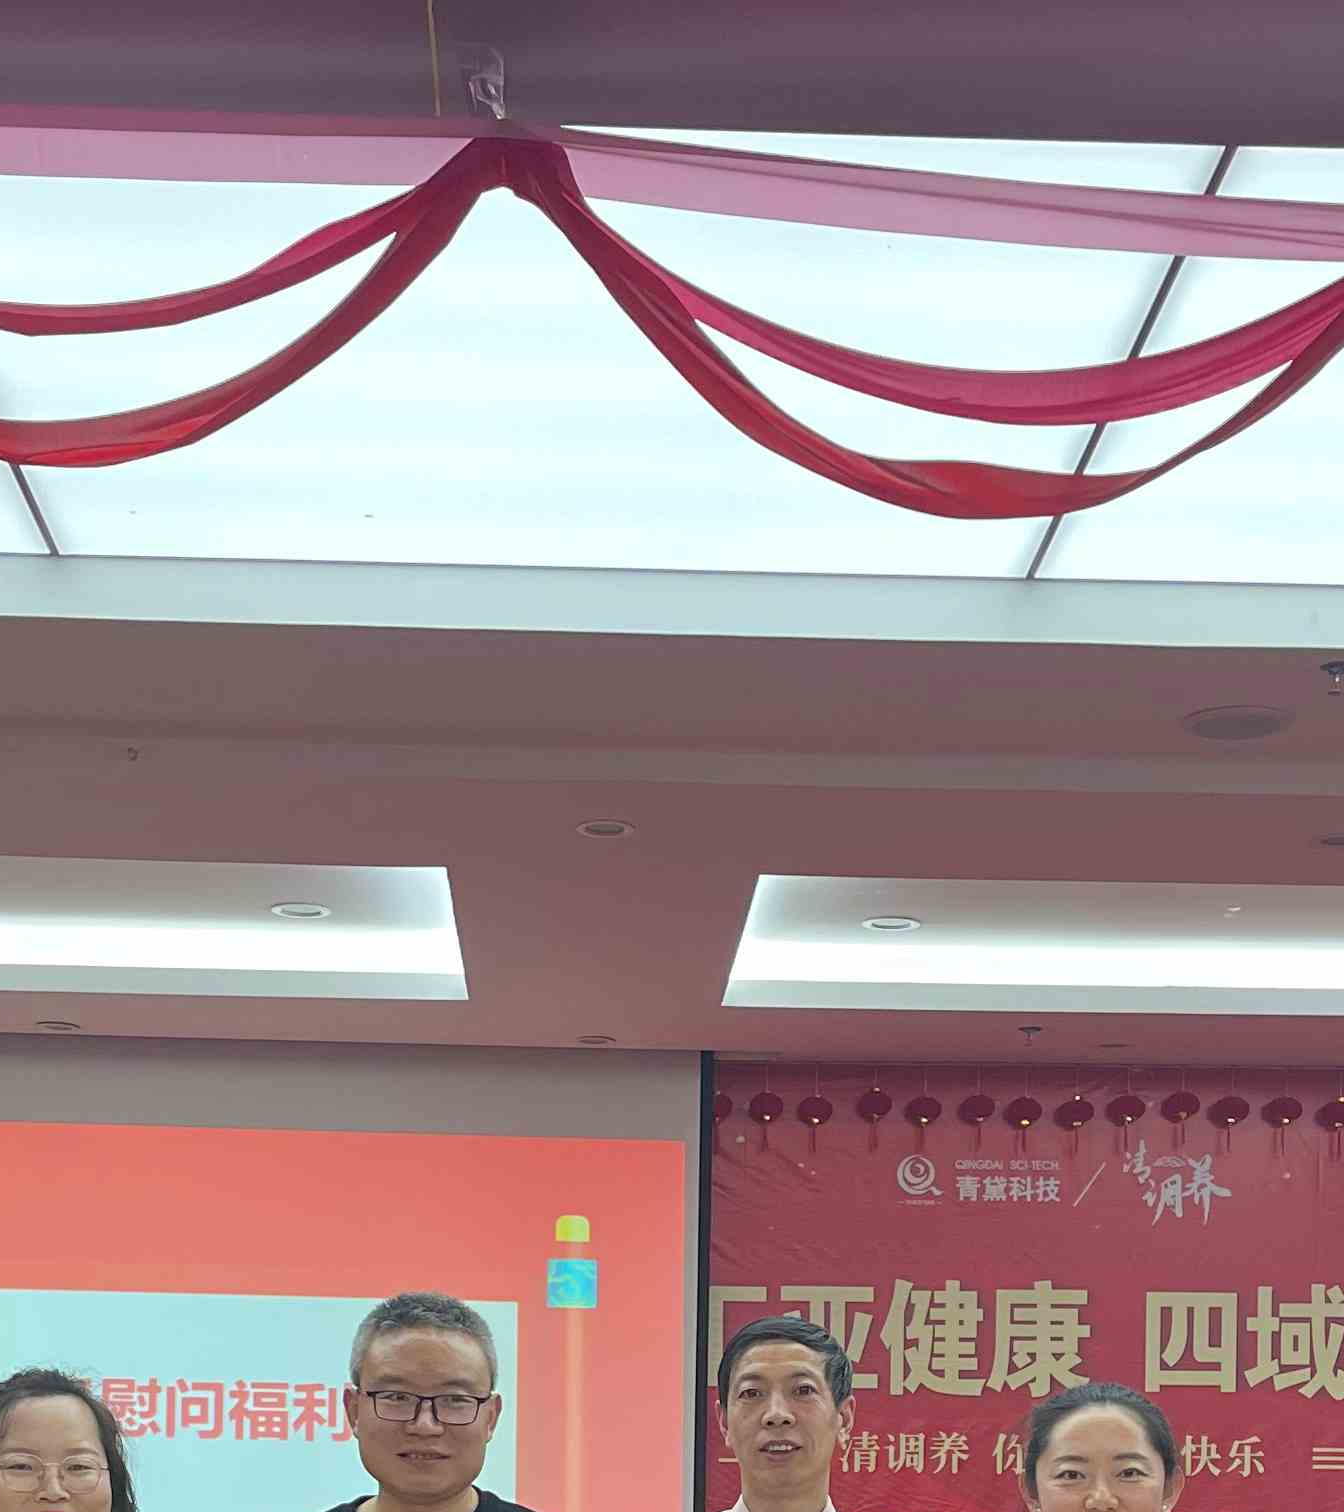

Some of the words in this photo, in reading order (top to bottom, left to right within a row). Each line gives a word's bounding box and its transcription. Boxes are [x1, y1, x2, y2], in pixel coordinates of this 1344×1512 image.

[954, 1159, 1004, 1171] QINGDAI
[955, 1176, 1061, 1203] 青黛科技
[1180, 1433, 1265, 1478] 快乐
